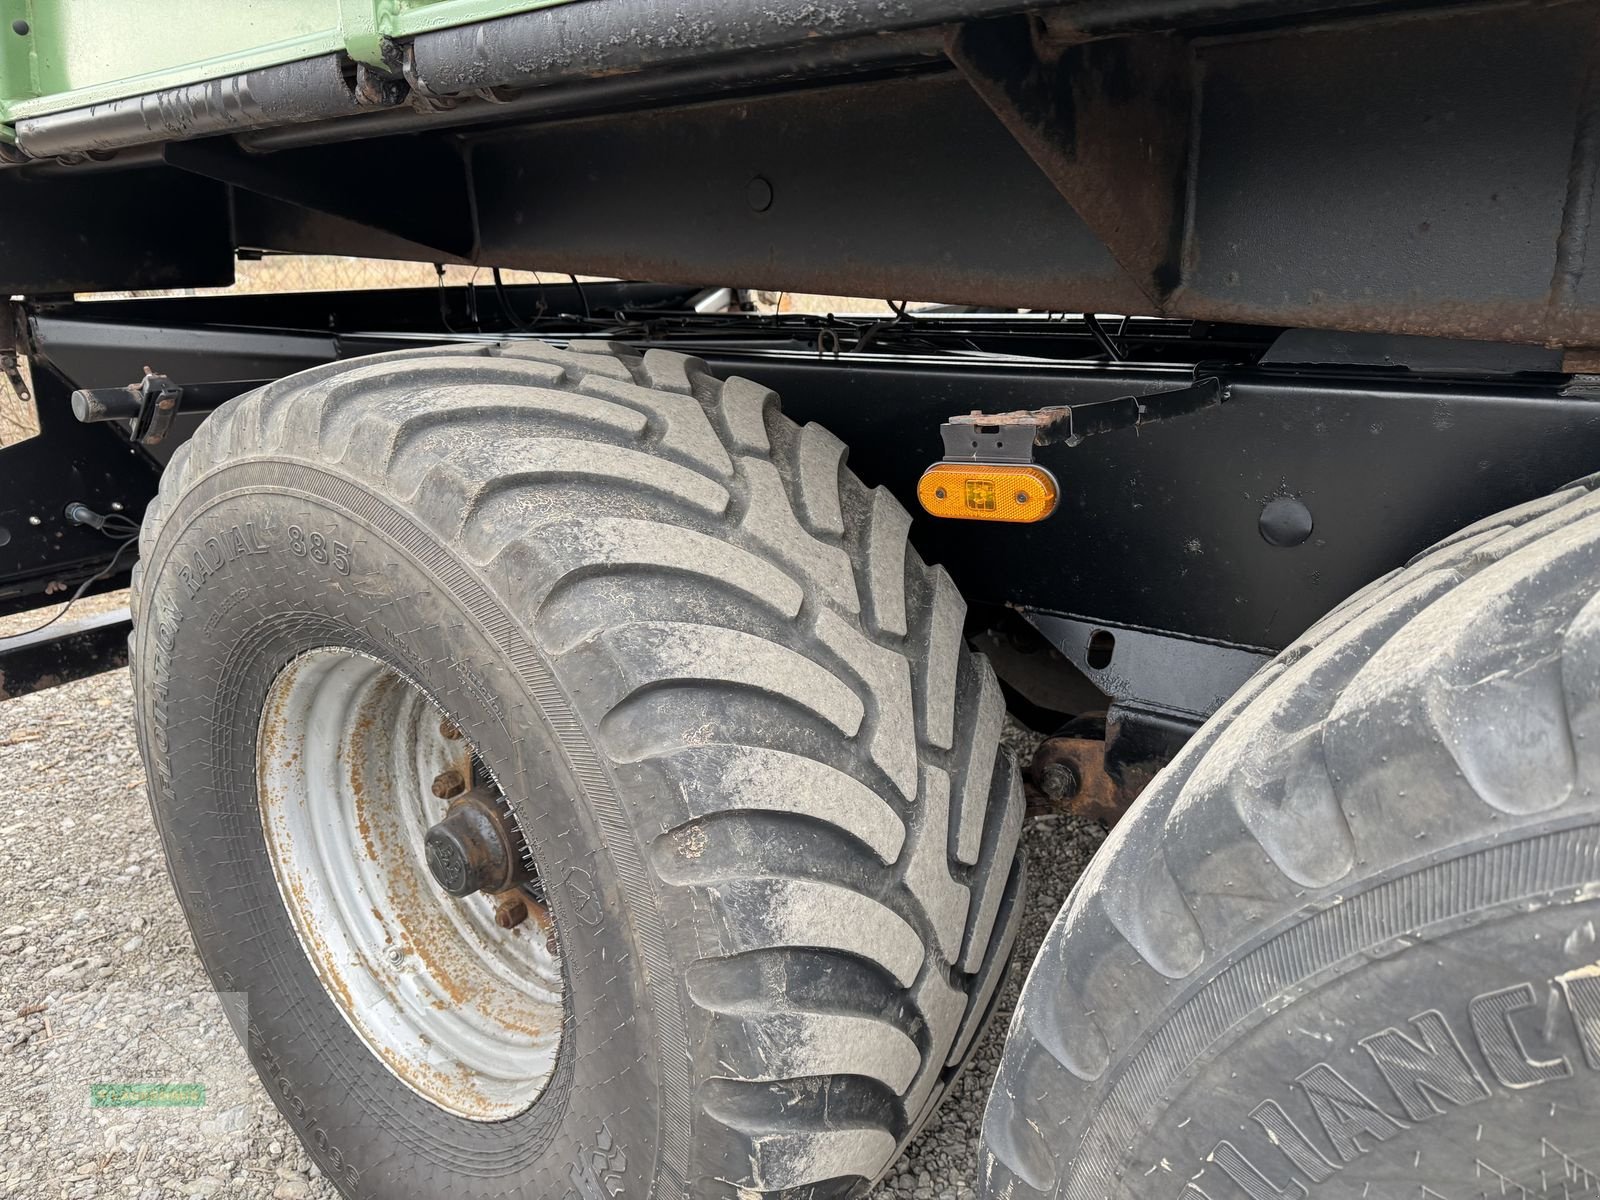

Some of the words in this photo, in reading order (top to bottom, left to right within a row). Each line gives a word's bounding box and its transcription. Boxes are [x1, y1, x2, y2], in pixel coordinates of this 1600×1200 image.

[153, 596, 185, 800] FLOTATION
[178, 522, 271, 600] RADIAL
[287, 524, 350, 577] 885
[1176, 958, 1600, 1200] LIANC
